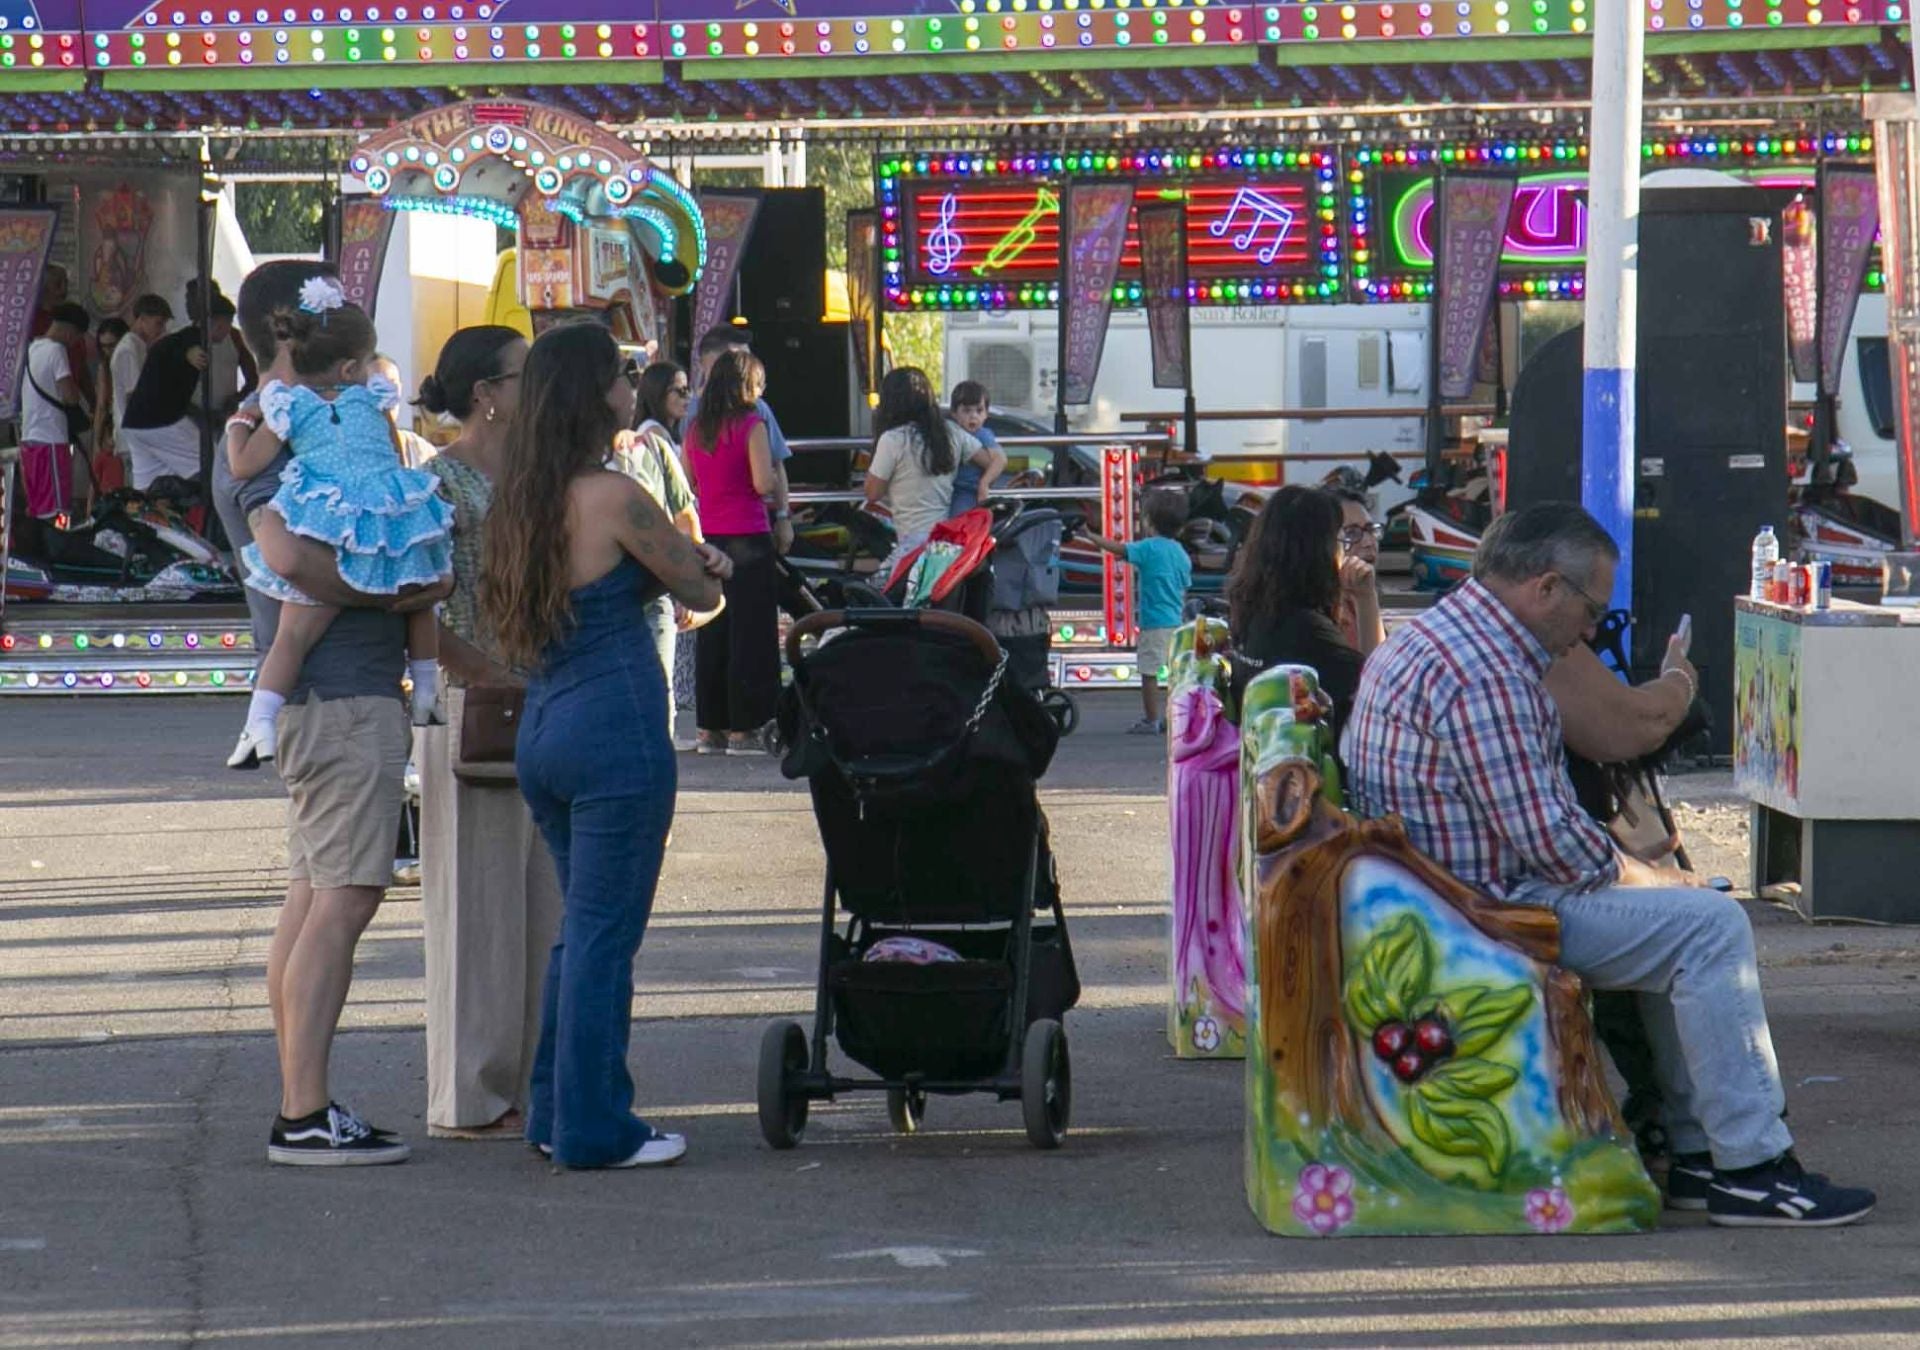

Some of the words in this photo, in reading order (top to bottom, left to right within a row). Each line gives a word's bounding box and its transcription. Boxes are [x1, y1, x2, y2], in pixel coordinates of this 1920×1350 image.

[417, 108, 467, 143] THE
[535, 111, 593, 147] KING
[1231, 303, 1281, 321] Roller
